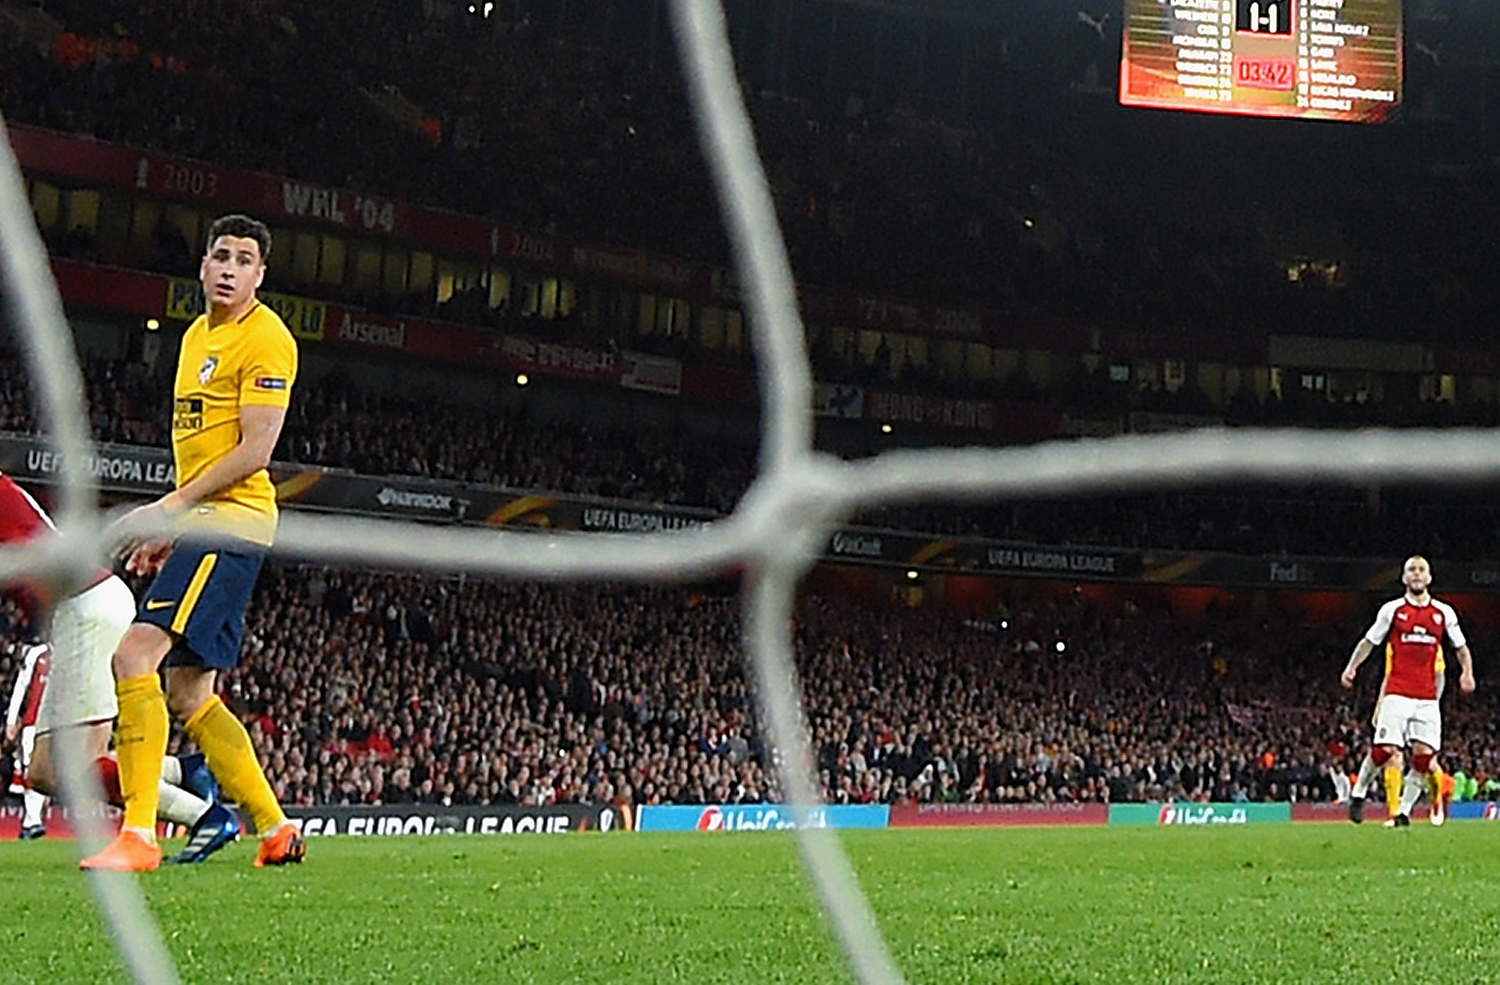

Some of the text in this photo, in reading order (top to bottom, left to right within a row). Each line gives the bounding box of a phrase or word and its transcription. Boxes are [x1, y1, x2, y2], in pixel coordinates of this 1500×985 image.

[282, 181, 396, 232] WHL '04
[338, 313, 406, 348] Arsenal
[27, 449, 176, 484] UEF UROPA LEA
